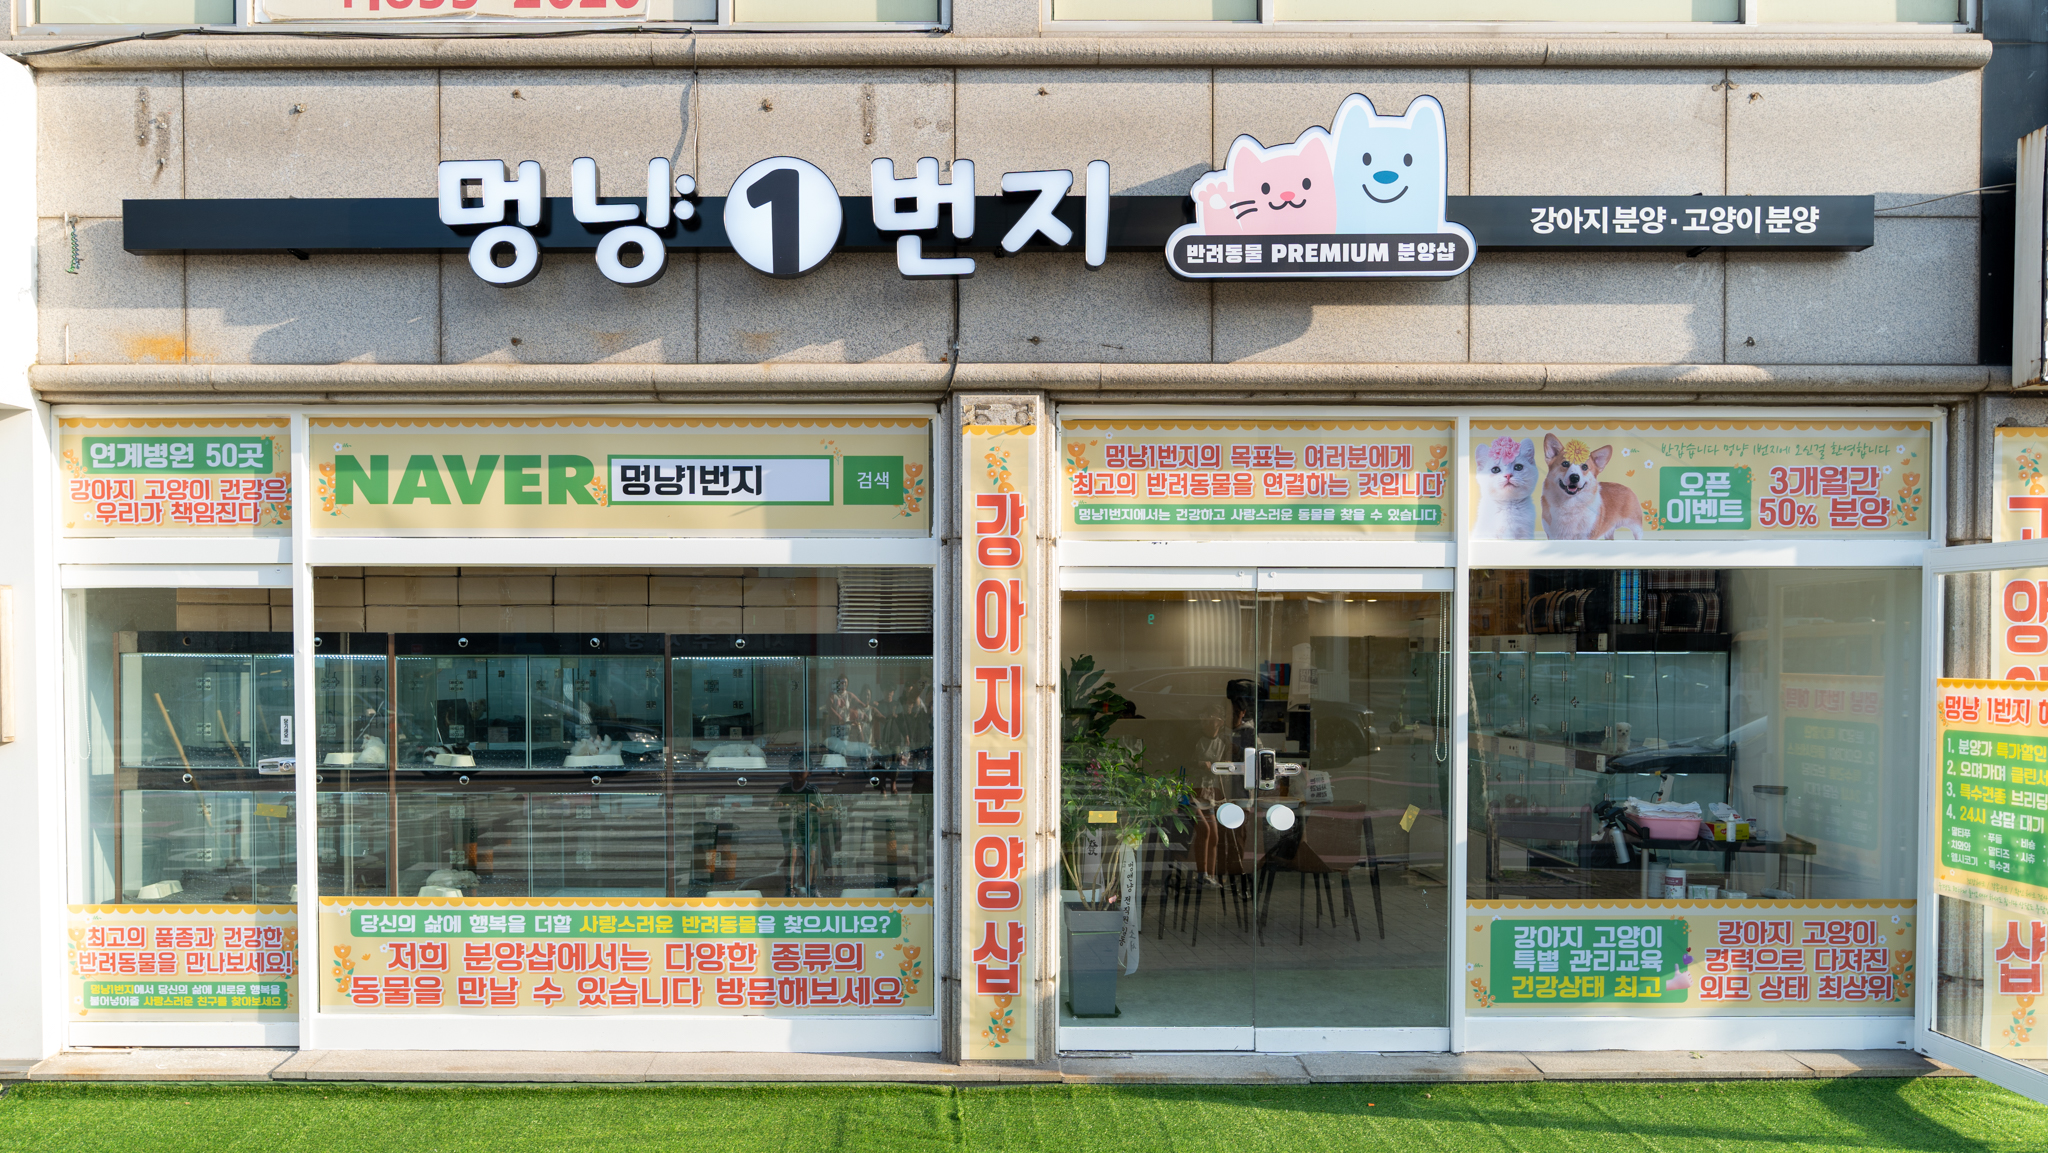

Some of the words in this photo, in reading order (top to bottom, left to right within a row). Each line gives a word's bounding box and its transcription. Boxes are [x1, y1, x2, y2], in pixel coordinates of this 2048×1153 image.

[1530, 206, 1608, 233] 강아지
[1612, 206, 1666, 233] 분양
[1682, 206, 1760, 233] 고양이
[1766, 206, 1820, 233] 분양
[1186, 244, 1263, 264] 반려동물
[1271, 243, 1389, 263] PREMIUM
[1398, 242, 1456, 262] 분양샵
[90, 443, 194, 469] 연계병원
[206, 443, 264, 468] 50곳
[1104, 444, 1221, 469] 멍냥1번지의
[1231, 444, 1296, 469] 목표는
[1304, 444, 1414, 469] 여러분에게
[1661, 442, 1720, 459] 반갑습니다
[1724, 443, 1750, 456] 멍냥
[1795, 443, 1826, 460] 오신걸
[1830, 442, 1891, 458] 환영합니다
[70, 479, 135, 501] 강아지
[143, 479, 210, 501] 고양이
[219, 479, 286, 501] 건강은
[335, 454, 598, 505] NAVER
[620, 464, 763, 497] 멍냥1번지
[857, 471, 889, 490] 검색
[1072, 473, 1136, 498] 최고의
[1147, 473, 1254, 498] 반려동물을
[1262, 473, 1350, 498] 연결하는
[1358, 473, 1444, 498] 것입니다
[1678, 472, 1732, 497] 오픈
[1770, 466, 1880, 496] 3개월간
[96, 501, 163, 524] 우리가
[170, 501, 260, 523] 책임진다
[1078, 508, 1171, 522] 멍냥1번지에서는
[1176, 508, 1226, 521] 건강하고
[1231, 508, 1293, 521] 사랑스러운
[1298, 508, 1335, 521] 동물을
[1340, 508, 1366, 521] 찾을
[1370, 508, 1383, 521] 수
[1388, 508, 1438, 521] 있습니다
[1666, 498, 1744, 524] 이벤트
[1759, 498, 1818, 527] 50%
[1828, 498, 1892, 528] 분양
[1945, 695, 1980, 722] 멍냥
[1986, 697, 2031, 725] 1번지
[973, 491, 1027, 998] 강아지분양샵
[1947, 738, 1954, 754] 1.
[1958, 738, 1992, 757] 분양가
[1997, 742, 2047, 762] 특가할인
[1946, 760, 1956, 776] 2.
[1960, 761, 2006, 782] 오며가며
[1946, 782, 1956, 798] 3.
[1960, 783, 2006, 804] 특수견종
[2011, 790, 2048, 811] 브리딩
[1946, 804, 1956, 820] 4.
[1960, 806, 1986, 824] 24시
[1990, 810, 2015, 829] 상담
[2020, 815, 2044, 834] 대기
[88, 927, 146, 948] 최고의
[155, 927, 214, 948] 품종과
[223, 926, 283, 948] 건강한
[361, 915, 416, 933] 당신의
[424, 915, 461, 933] 삶에
[469, 915, 526, 933] 행복을
[535, 915, 571, 933] 더할
[580, 915, 673, 933] 사랑스러운
[682, 916, 776, 934] 반려동물을
[784, 915, 891, 934] 찾으시나요?
[1718, 921, 1791, 945] 강아지
[1802, 921, 1877, 945] 고양이
[1514, 926, 1583, 949] 강아지
[1593, 926, 1663, 949] 고양이
[78, 952, 177, 973] 반려동물을
[186, 952, 292, 973] 만나보세요!
[387, 942, 448, 971] 저희
[463, 942, 651, 972] 분양샵에서는
[664, 942, 758, 972] 다양한
[770, 942, 863, 972] 종류의
[1512, 950, 1559, 973] 특별
[1569, 950, 1663, 973] 관리교육
[1705, 948, 1803, 973] 경력으로
[1814, 948, 1888, 973] 다져진
[158, 985, 188, 995] 당신의
[192, 985, 212, 995] 삶에
[216, 985, 246, 995] 새로운
[250, 985, 280, 995] 행복을
[351, 976, 444, 1005] 동물을
[457, 976, 519, 1005] 만날
[533, 976, 563, 1005] 수
[577, 976, 702, 1006] 있습니다
[716, 976, 903, 1006] 방문해보세요
[1512, 975, 1604, 998] 건강상태
[1615, 975, 1661, 998] 최고
[1699, 975, 1750, 1000] 외모
[1759, 975, 1808, 1000] 상태
[1818, 975, 1893, 1000] 최상위
[144, 996, 193, 1006] 사랑스러운
[198, 996, 227, 1006] 친구를
